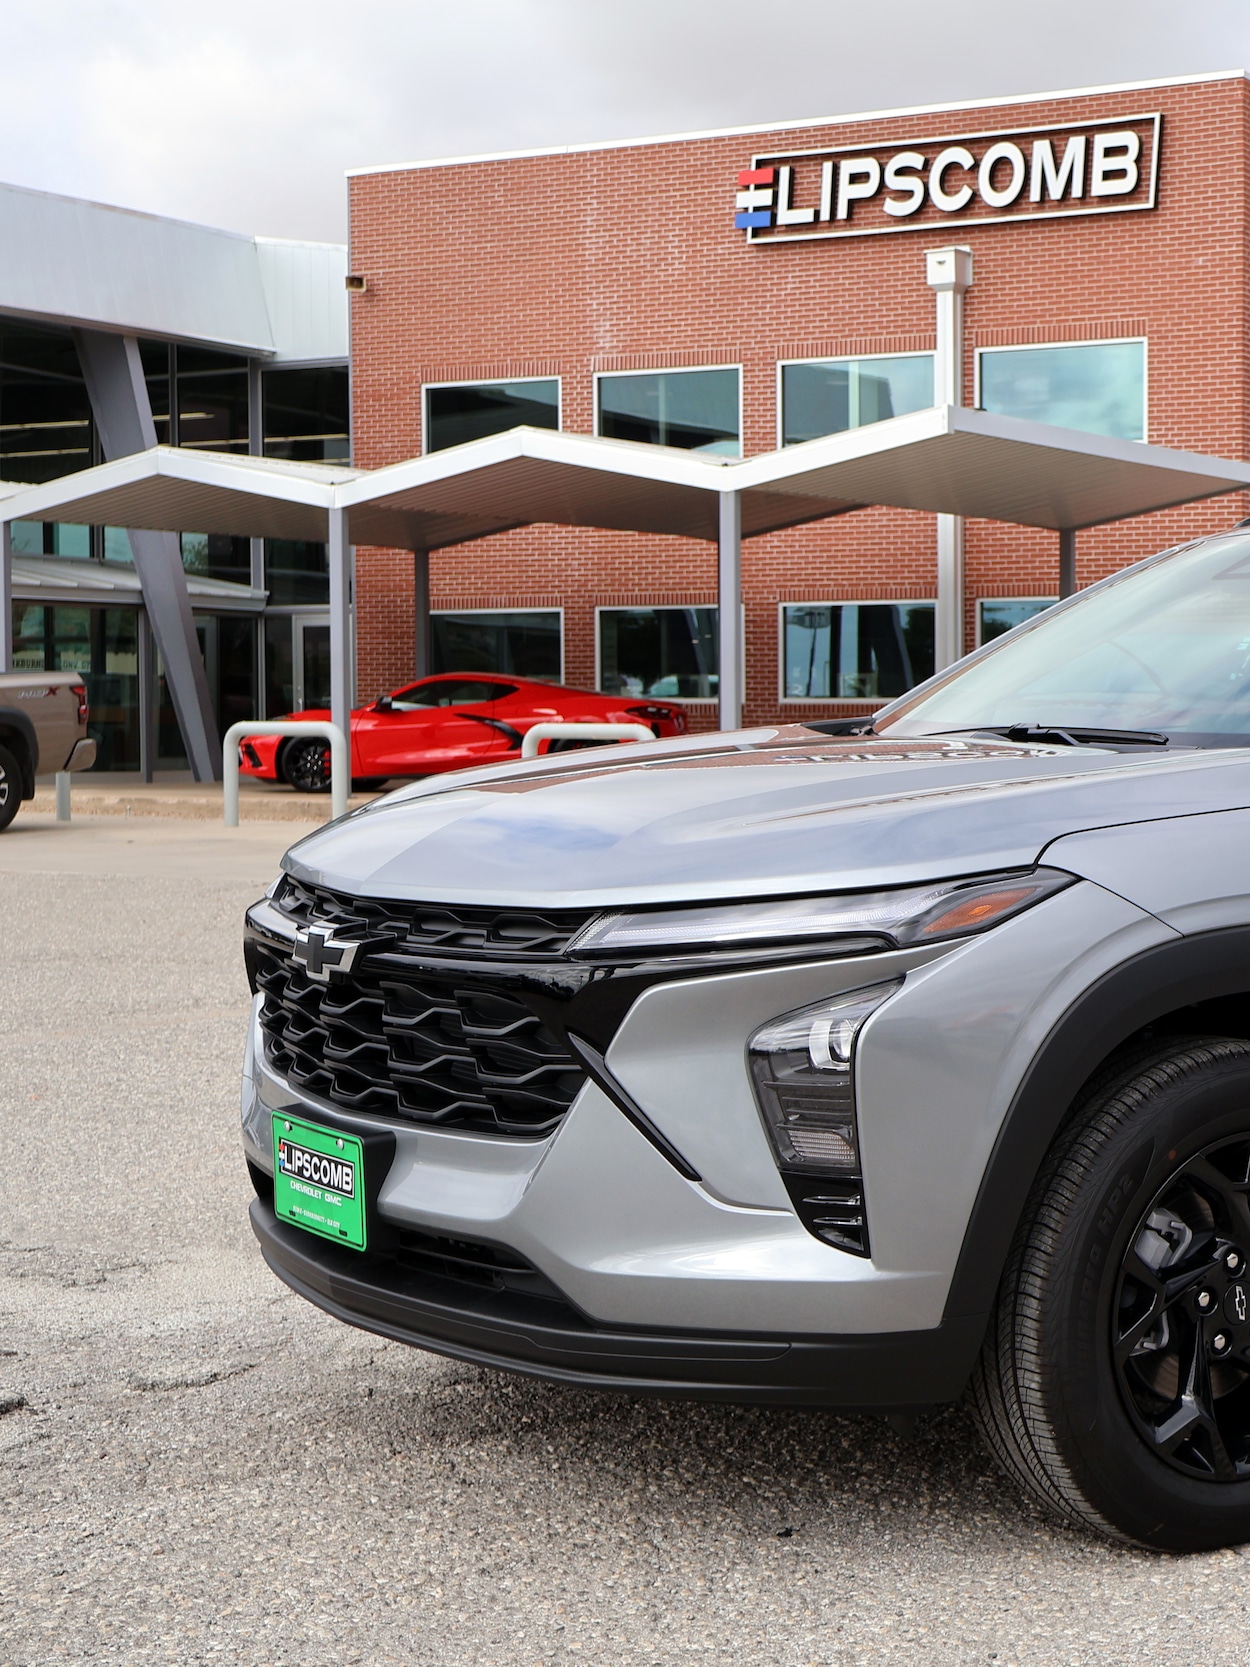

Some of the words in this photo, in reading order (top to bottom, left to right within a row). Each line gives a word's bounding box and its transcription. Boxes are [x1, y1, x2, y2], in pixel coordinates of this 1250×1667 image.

[776, 130, 1141, 226] LIPSCOMB
[284, 1145, 353, 1191] LIPSCOMB
[290, 1180, 322, 1200] CHEVROLET
[325, 1193, 342, 1206] GMC
